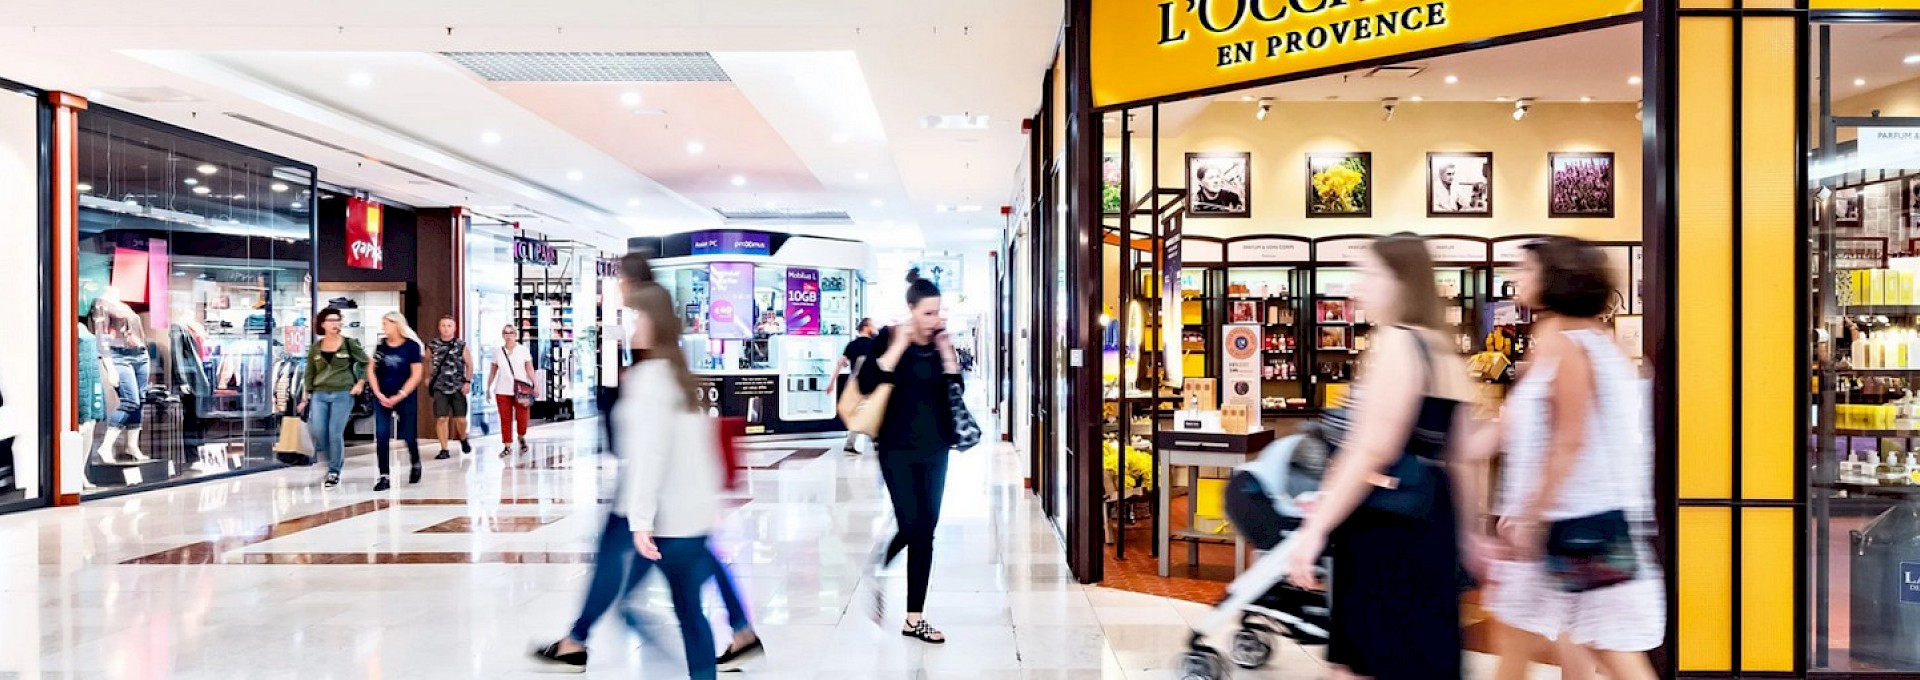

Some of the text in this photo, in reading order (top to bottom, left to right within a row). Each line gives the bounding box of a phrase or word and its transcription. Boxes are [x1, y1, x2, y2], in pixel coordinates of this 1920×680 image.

[1216, 3, 1445, 67] EN PROVENCE
[788, 290, 817, 303] 10GB
